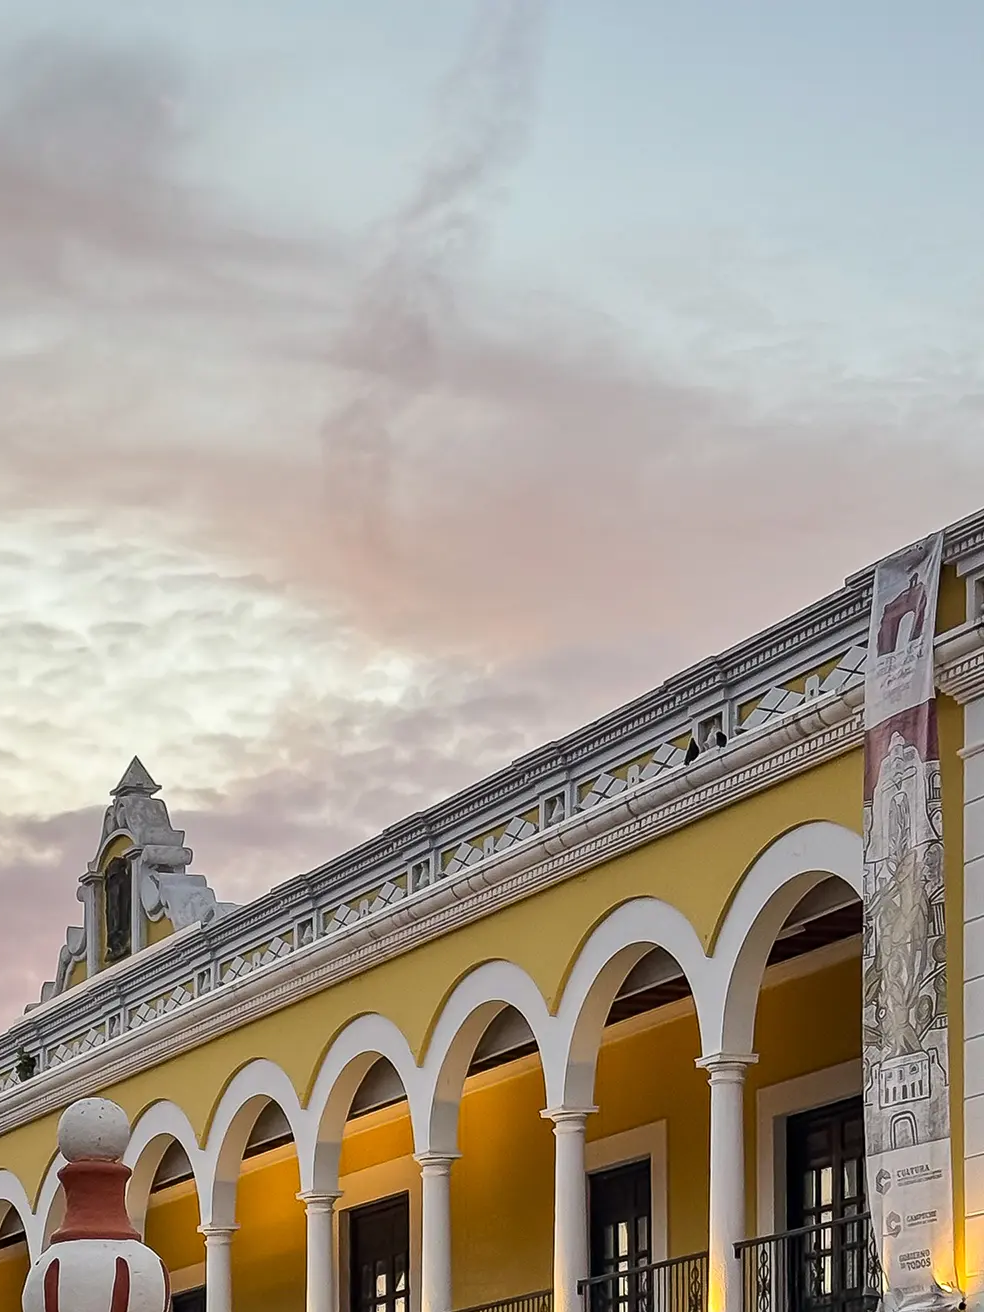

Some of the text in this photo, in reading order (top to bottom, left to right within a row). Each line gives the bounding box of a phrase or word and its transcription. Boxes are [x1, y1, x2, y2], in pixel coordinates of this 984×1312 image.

[897, 1164, 930, 1178] CULTURA
[899, 1249, 930, 1262] GOBIERNO
[906, 1257, 931, 1271] TODOS
